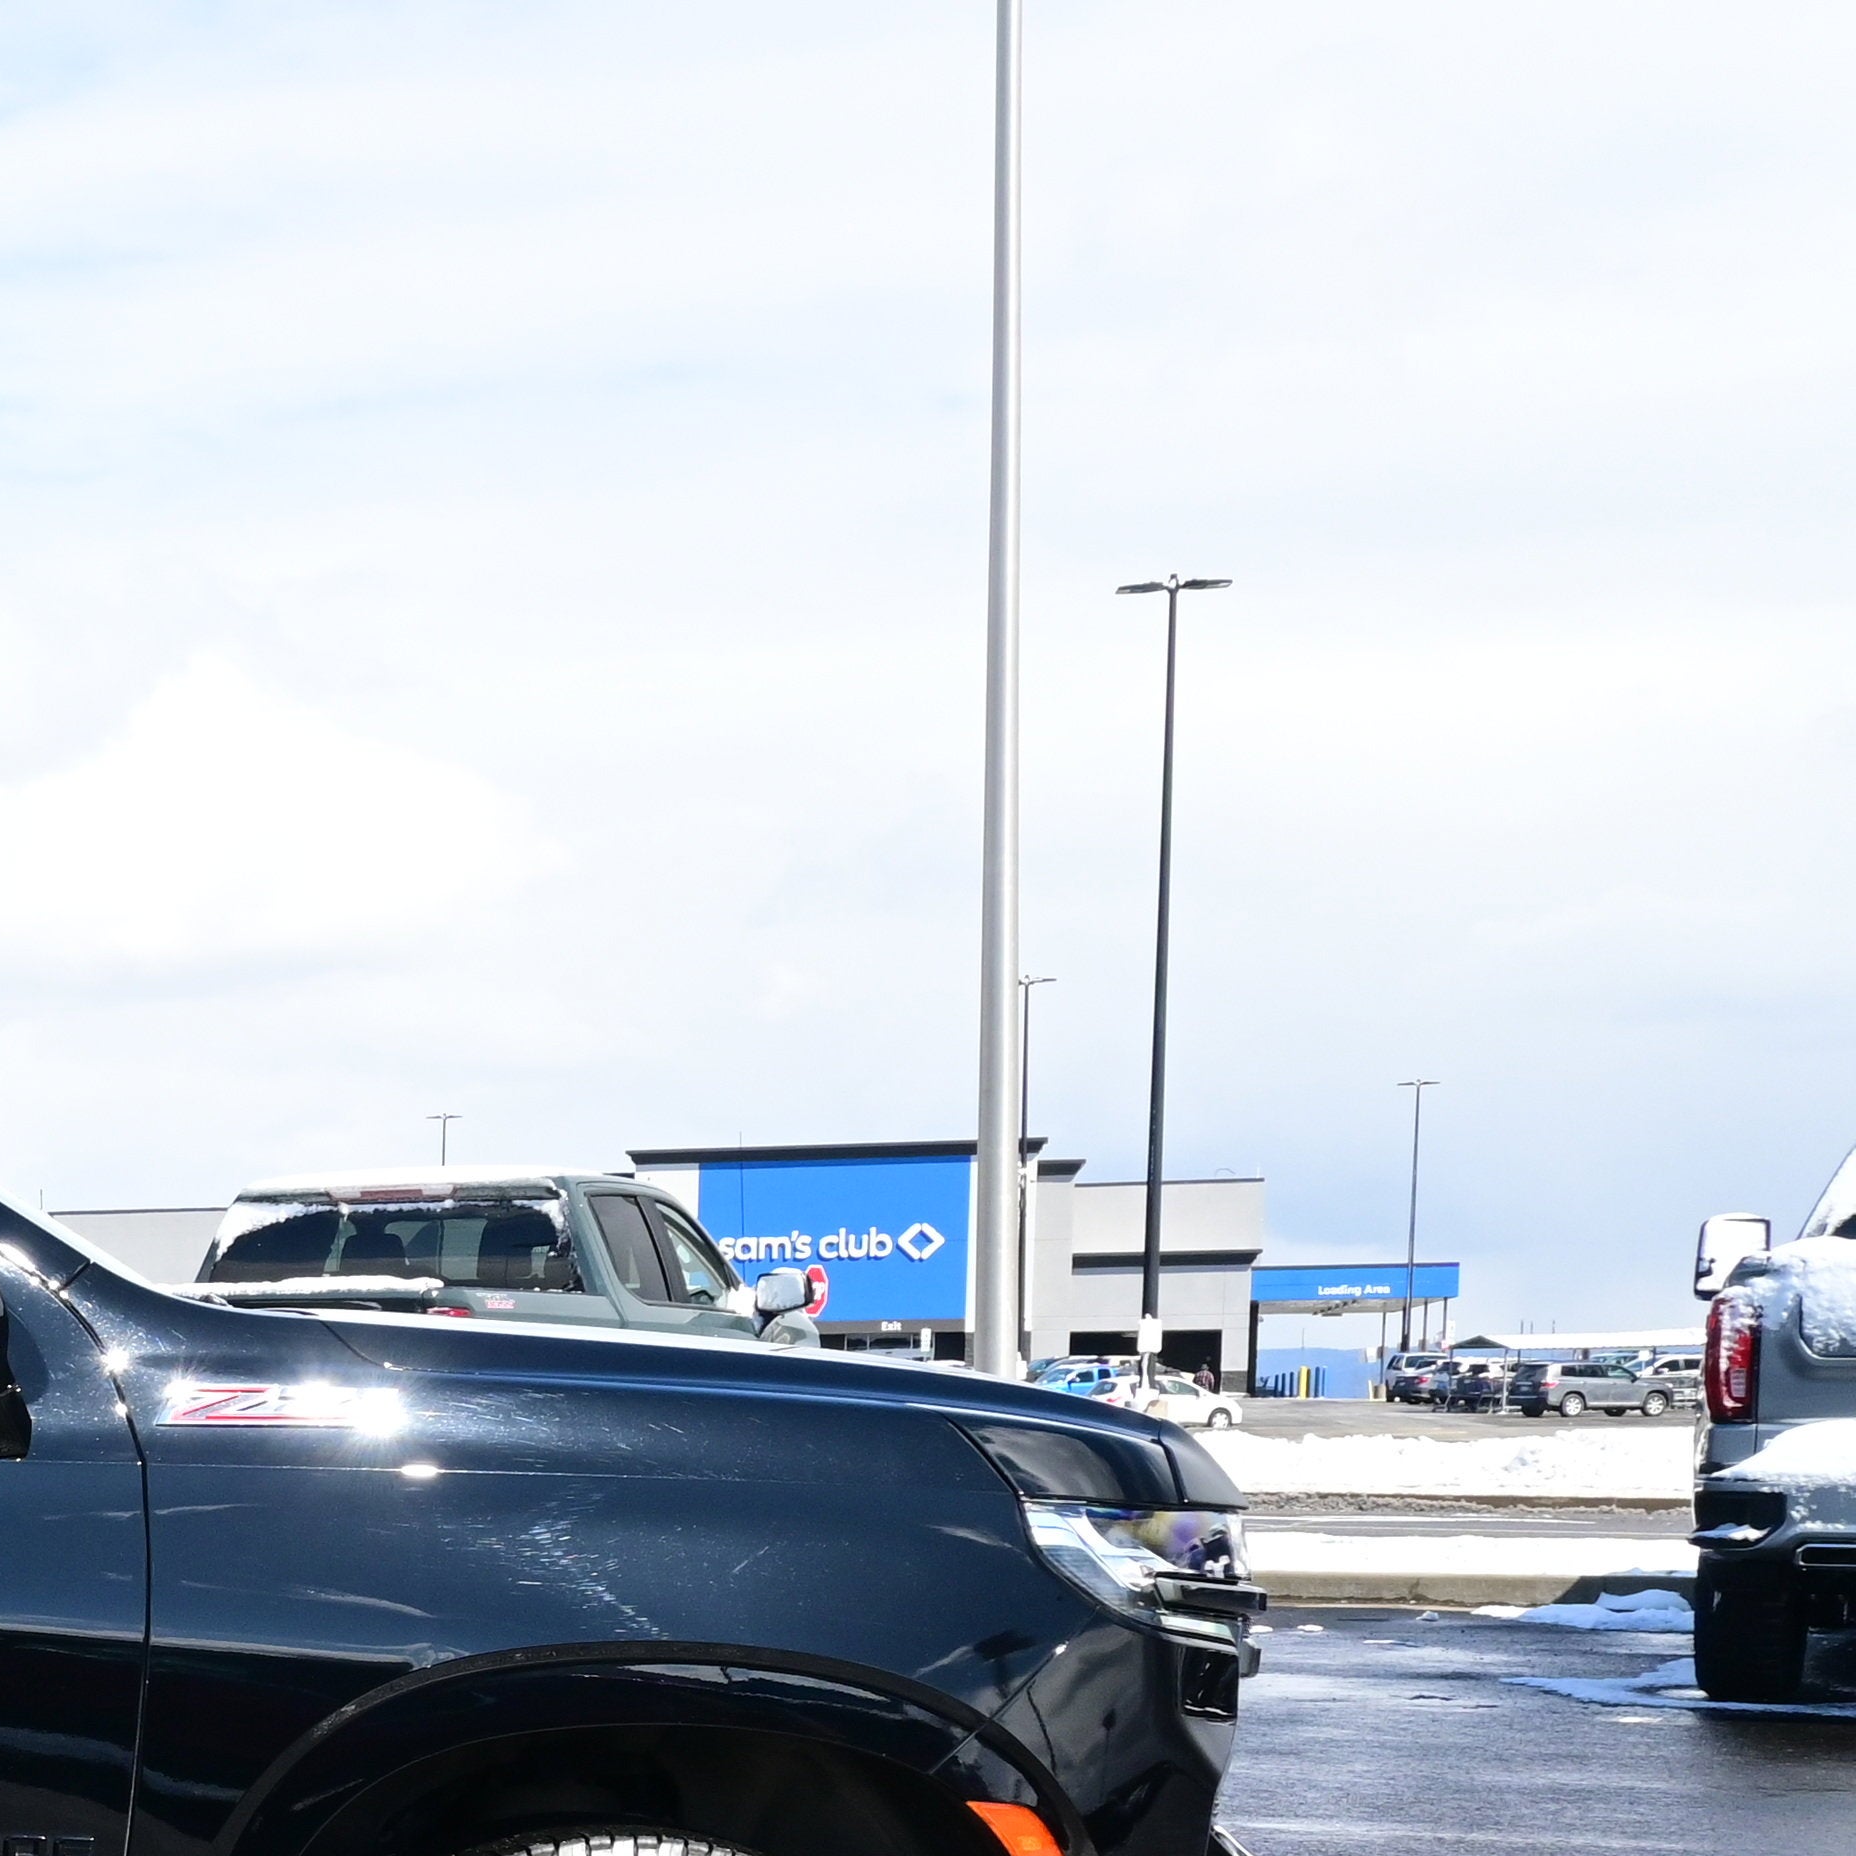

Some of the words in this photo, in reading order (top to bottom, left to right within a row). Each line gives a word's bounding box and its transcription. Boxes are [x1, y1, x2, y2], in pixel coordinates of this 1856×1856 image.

[718, 1230, 811, 1260] sam's
[819, 1227, 893, 1258] club
[1318, 1285, 1362, 1296] Loading
[1365, 1284, 1391, 1294] Area
